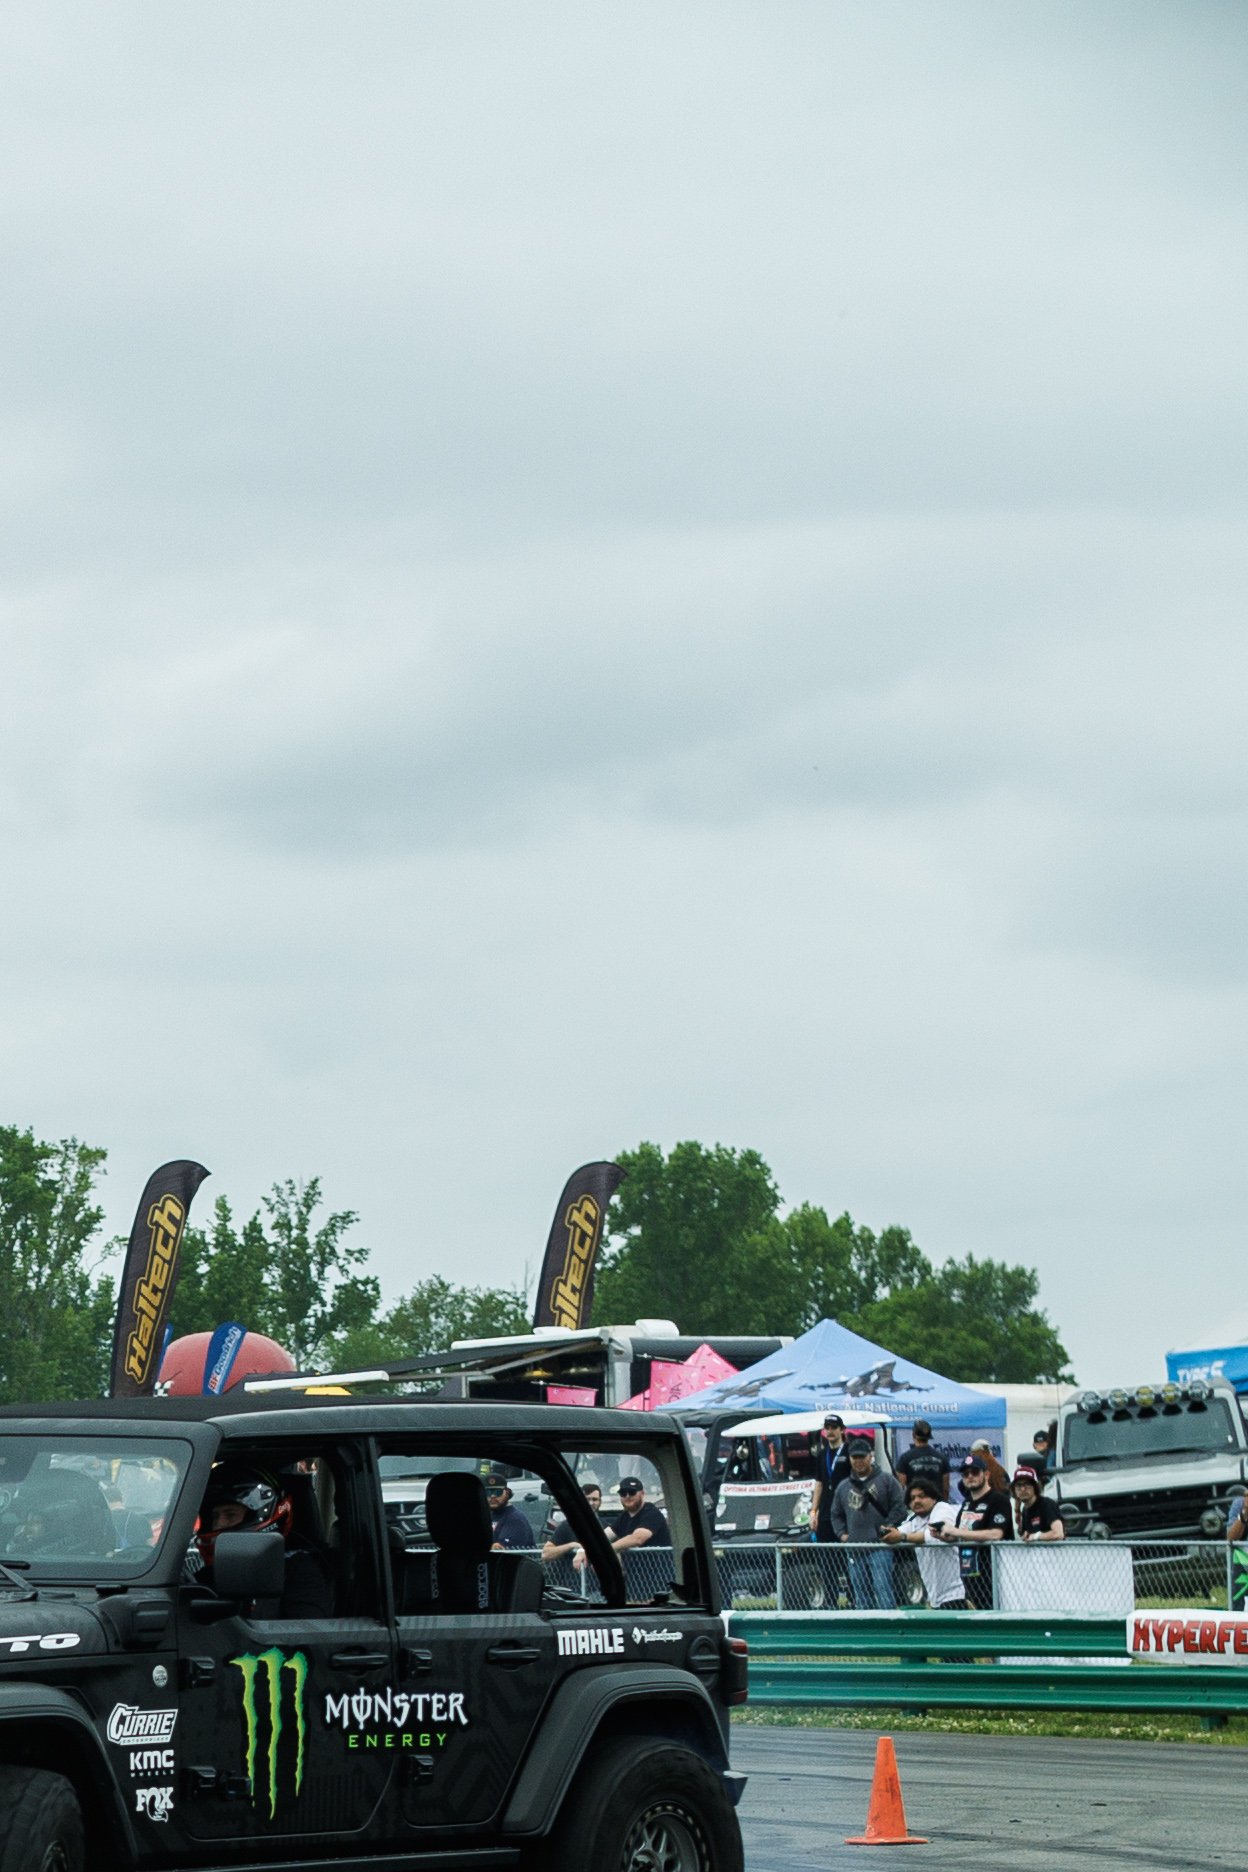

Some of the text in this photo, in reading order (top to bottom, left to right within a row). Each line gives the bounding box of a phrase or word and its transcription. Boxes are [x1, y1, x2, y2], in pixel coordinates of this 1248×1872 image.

[555, 1198, 597, 1330] altech
[127, 1197, 184, 1381] Haltech
[864, 1402, 918, 1413] National
[921, 1402, 959, 1413] Guard
[557, 1628, 625, 1656] MAHLE
[109, 1706, 175, 1739] CURRIE
[325, 1686, 469, 1731] MONSTER
[348, 1733, 447, 1748] ENERGY
[130, 1749, 175, 1770] KMC
[136, 1786, 174, 1820] FOX
